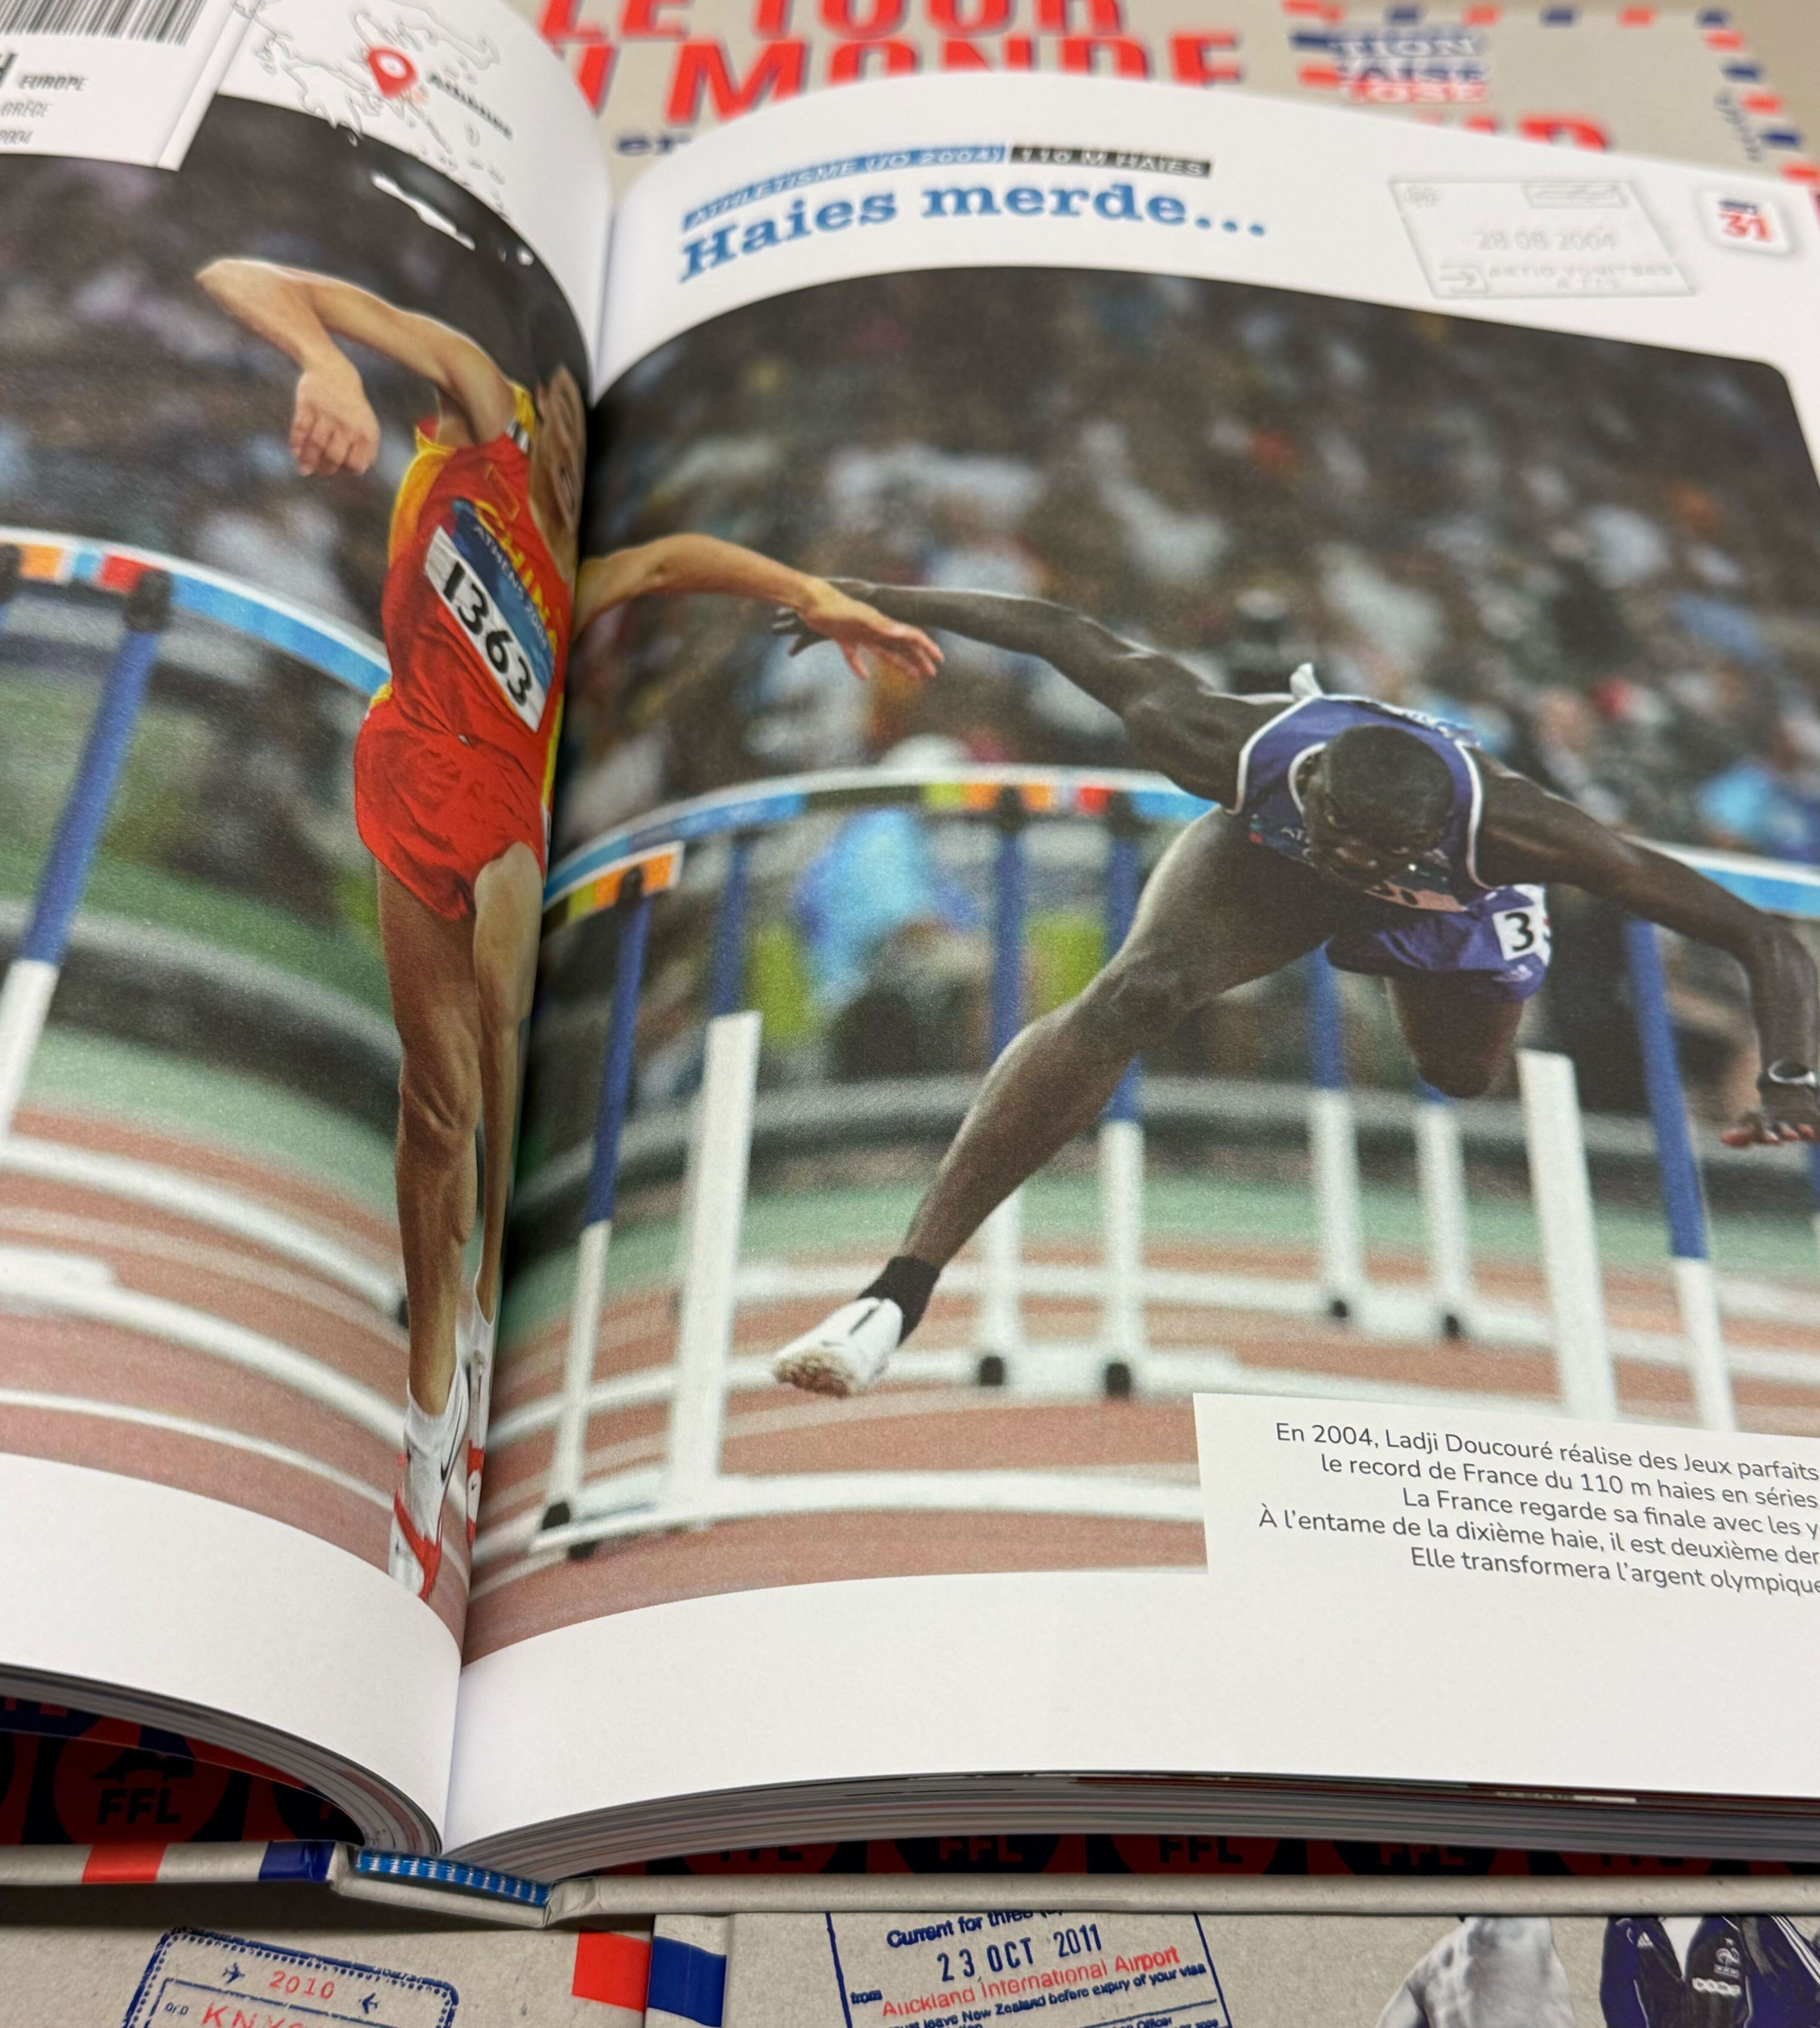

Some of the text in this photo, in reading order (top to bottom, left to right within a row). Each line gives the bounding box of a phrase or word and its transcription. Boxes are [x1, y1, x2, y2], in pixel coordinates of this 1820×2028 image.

[1082, 150, 1107, 166] M
[1118, 151, 1204, 176] HAIES
[680, 192, 898, 283] Haies
[1719, 211, 1772, 242] 31
[442, 561, 533, 708] 1363
[1505, 912, 1534, 953] 3
[1277, 1423, 1819, 1481] En 2004, Ladji Doucouré réalise des Jeux parfaits
[1322, 1454, 1818, 1508] le record de France du 110 m haies en séries
[1259, 1503, 1277, 1527] À
[1393, 1517, 1421, 1536] de
[1427, 1518, 1448, 1538] la
[1456, 1521, 1544, 1545] dixième
[1551, 1527, 1604, 1552] haie,
[1610, 1532, 1625, 1552] il
[1631, 1538, 1666, 1555] est
[1671, 1539, 1778, 1562] deuxième
[1785, 1545, 1819, 1564] der
[1403, 1487, 1430, 1507] La
[1437, 1490, 1513, 1513] France
[1520, 1501, 1607, 1521] regarde
[1614, 1509, 1638, 1523] sa
[1643, 1506, 1706, 1529] finale
[1713, 1517, 1763, 1533] avec
[1768, 1515, 1801, 1535] les
[1411, 1547, 1455, 1568] Elle
[1461, 1551, 1610, 1579] transformera
[1711, 1571, 1820, 1597] olympique
[98, 1789, 182, 1823] FFL
[887, 1919, 954, 1948] Current
[957, 1915, 983, 1933] for
[987, 1937, 1033, 1972] OCT
[1053, 1924, 1102, 1958] 2011
[268, 1970, 335, 2000] 2010
[883, 1945, 1180, 2017] Auckland International Airport
[962, 2009, 992, 2023] New
[995, 1994, 1046, 2016] Zealand
[1049, 1988, 1090, 2005] before
[1133, 1973, 1146, 1988] of
[1149, 1968, 1177, 1986] your
[1179, 1963, 1207, 1976] visa
